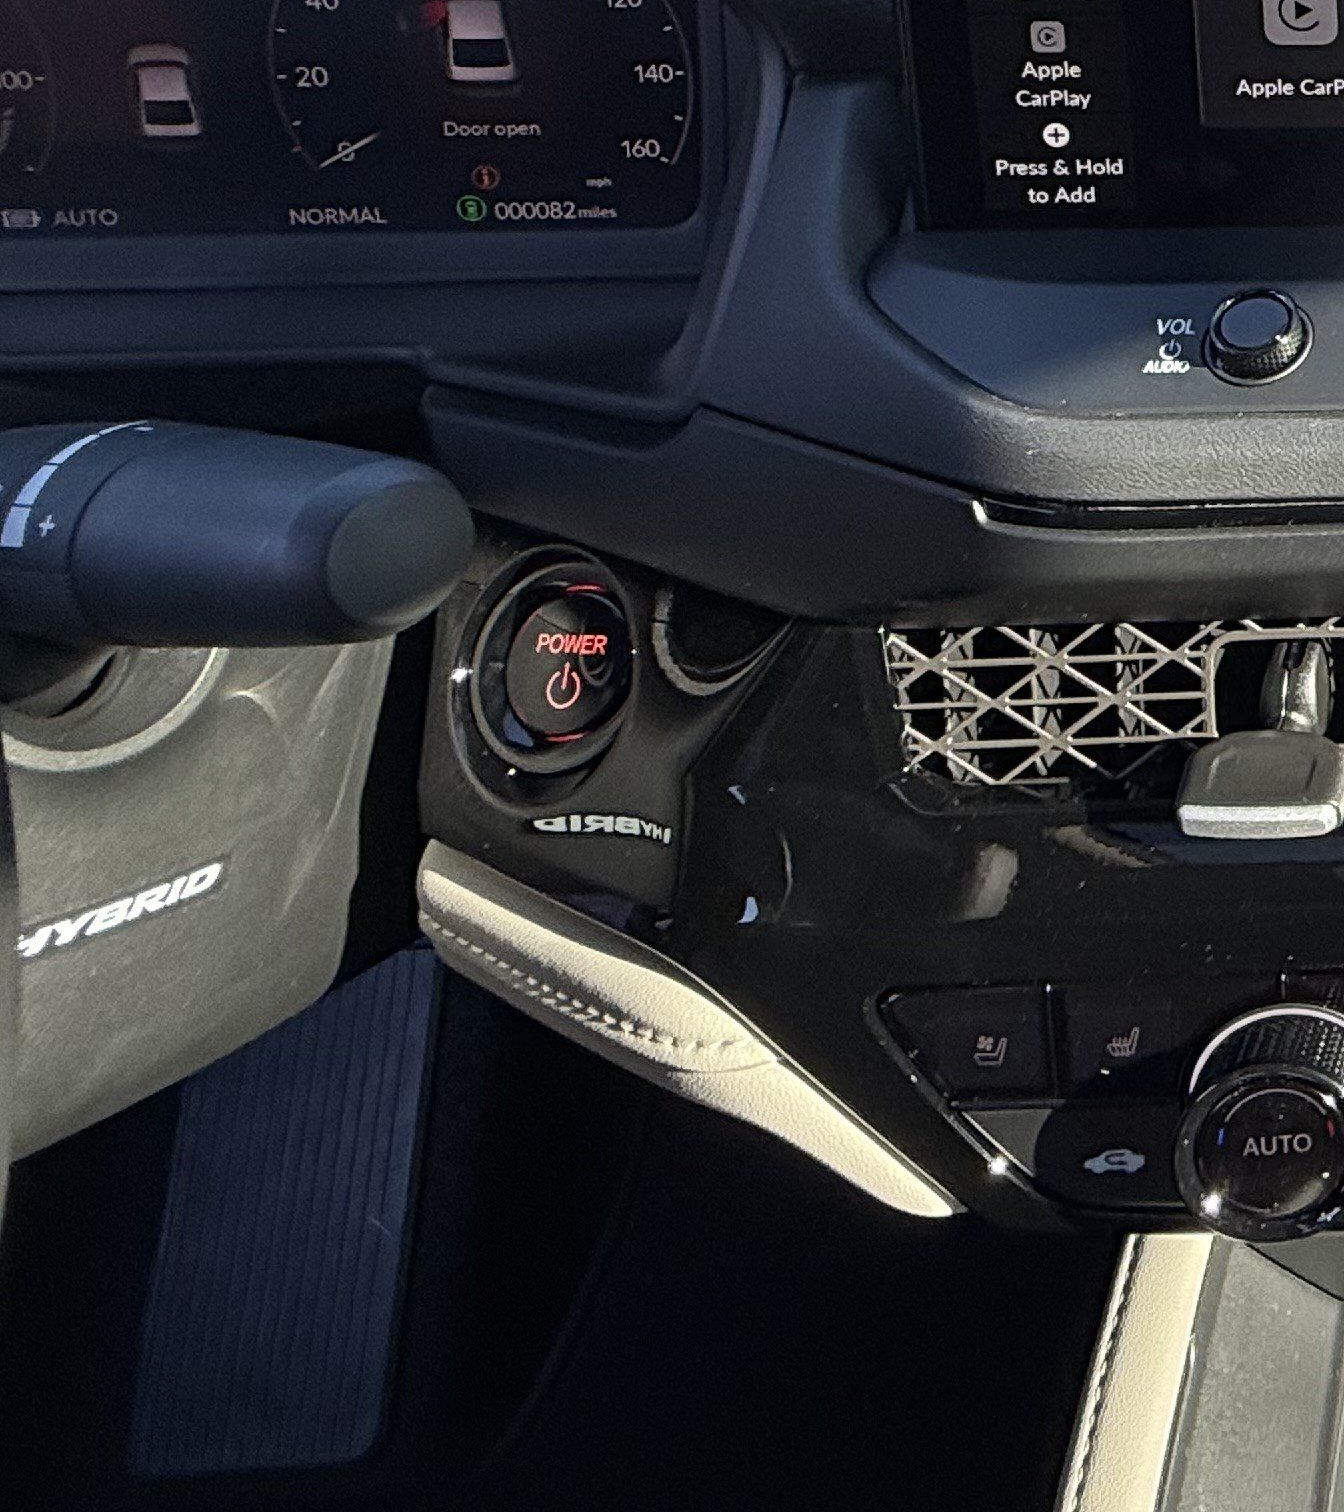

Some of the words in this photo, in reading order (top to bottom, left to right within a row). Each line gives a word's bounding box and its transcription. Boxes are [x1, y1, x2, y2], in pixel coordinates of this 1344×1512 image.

[295, 66, 329, 88] 20
[633, 62, 675, 83] 140
[1021, 60, 1082, 84] Apple
[1236, 78, 1295, 100] Apple
[1015, 88, 1092, 112] CarPlay
[443, 120, 491, 137] Door
[495, 122, 542, 142] open
[620, 138, 661, 159] 160
[995, 159, 1050, 177] Press
[1054, 159, 1069, 177] &
[1075, 157, 1124, 177] Hold
[1027, 187, 1047, 205] to
[1052, 185, 1096, 205] Add
[53, 207, 119, 227] AUTO
[289, 207, 388, 226] NORMAL
[494, 200, 577, 220] 000082
[578, 204, 618, 220] miles
[1157, 319, 1196, 336] VOL
[1142, 360, 1191, 374] AUDIO
[536, 634, 609, 655] POWER
[1243, 1132, 1313, 1158] AUTO
